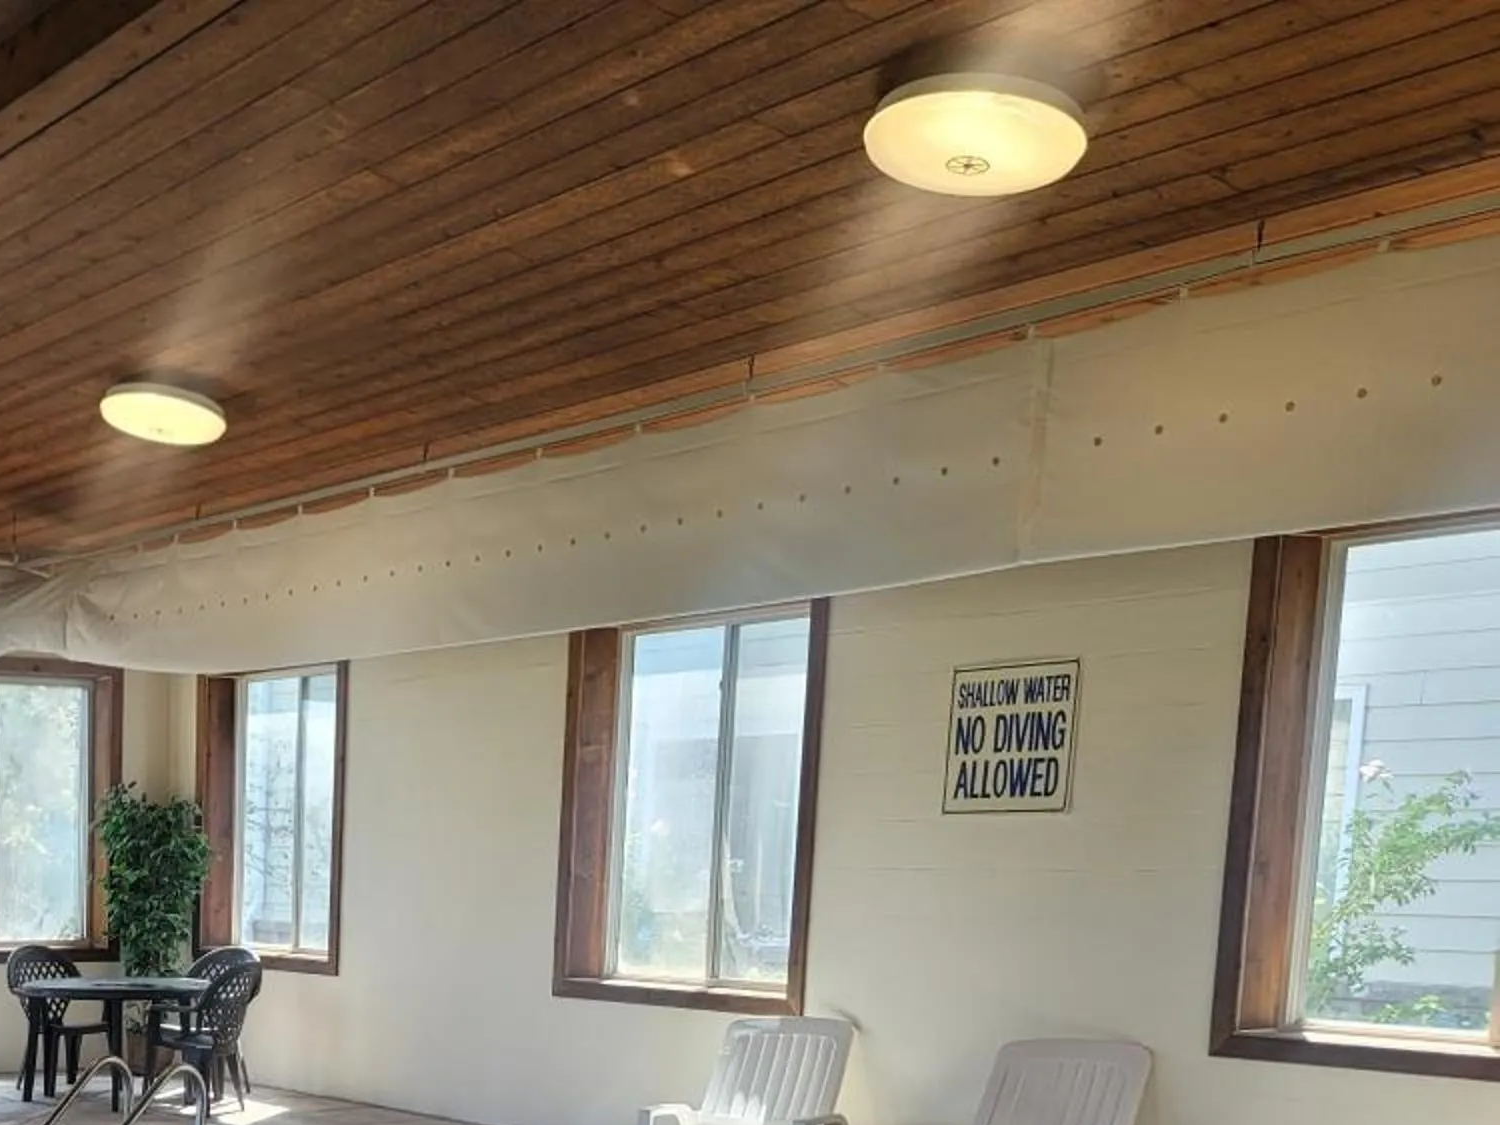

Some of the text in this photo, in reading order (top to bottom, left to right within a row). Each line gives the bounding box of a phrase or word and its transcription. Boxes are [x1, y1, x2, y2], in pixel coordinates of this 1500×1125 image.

[957, 673, 1072, 710] SHALLOW WATER
[955, 709, 1067, 756] NO DIVING
[953, 756, 1060, 800] ALLOWED
